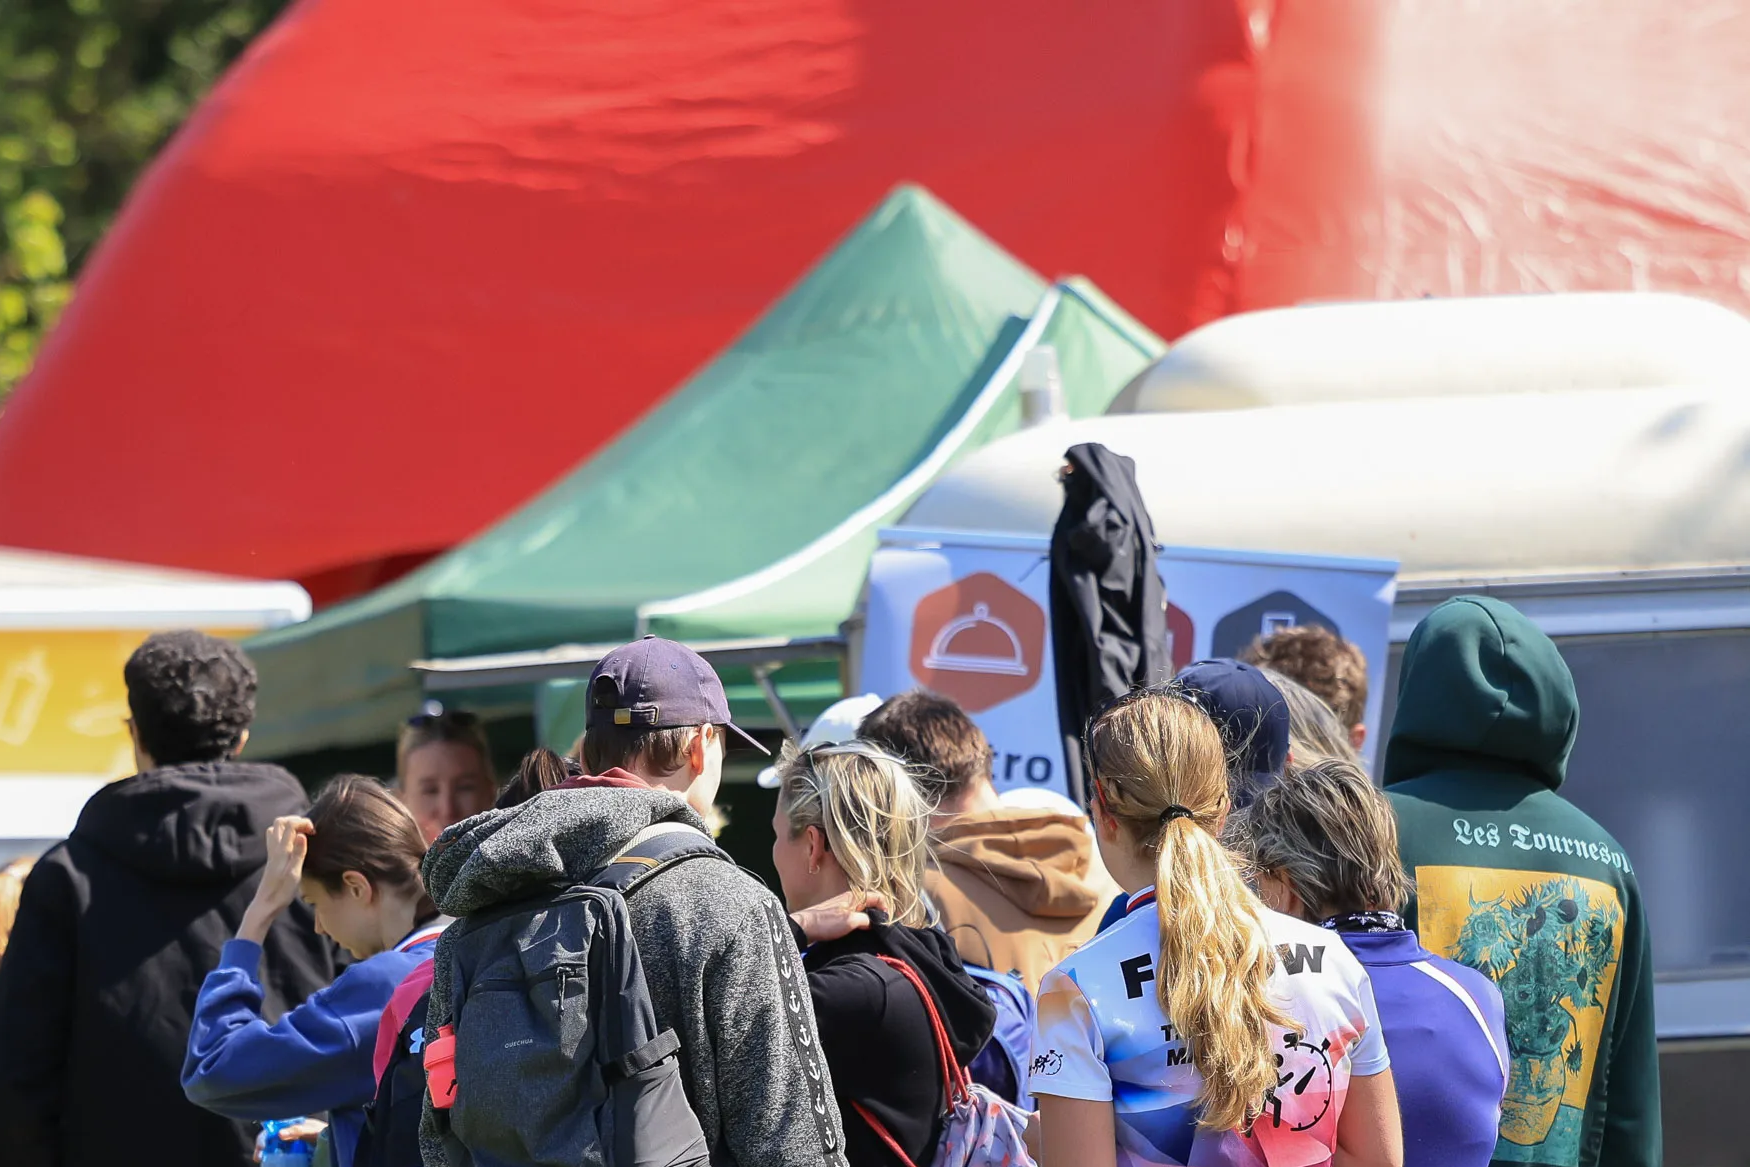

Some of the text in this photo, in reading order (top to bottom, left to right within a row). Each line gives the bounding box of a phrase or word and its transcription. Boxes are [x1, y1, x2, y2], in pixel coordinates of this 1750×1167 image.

[1452, 818, 1635, 876] Les Tournesol
[504, 1038, 534, 1049] QUECHUA
